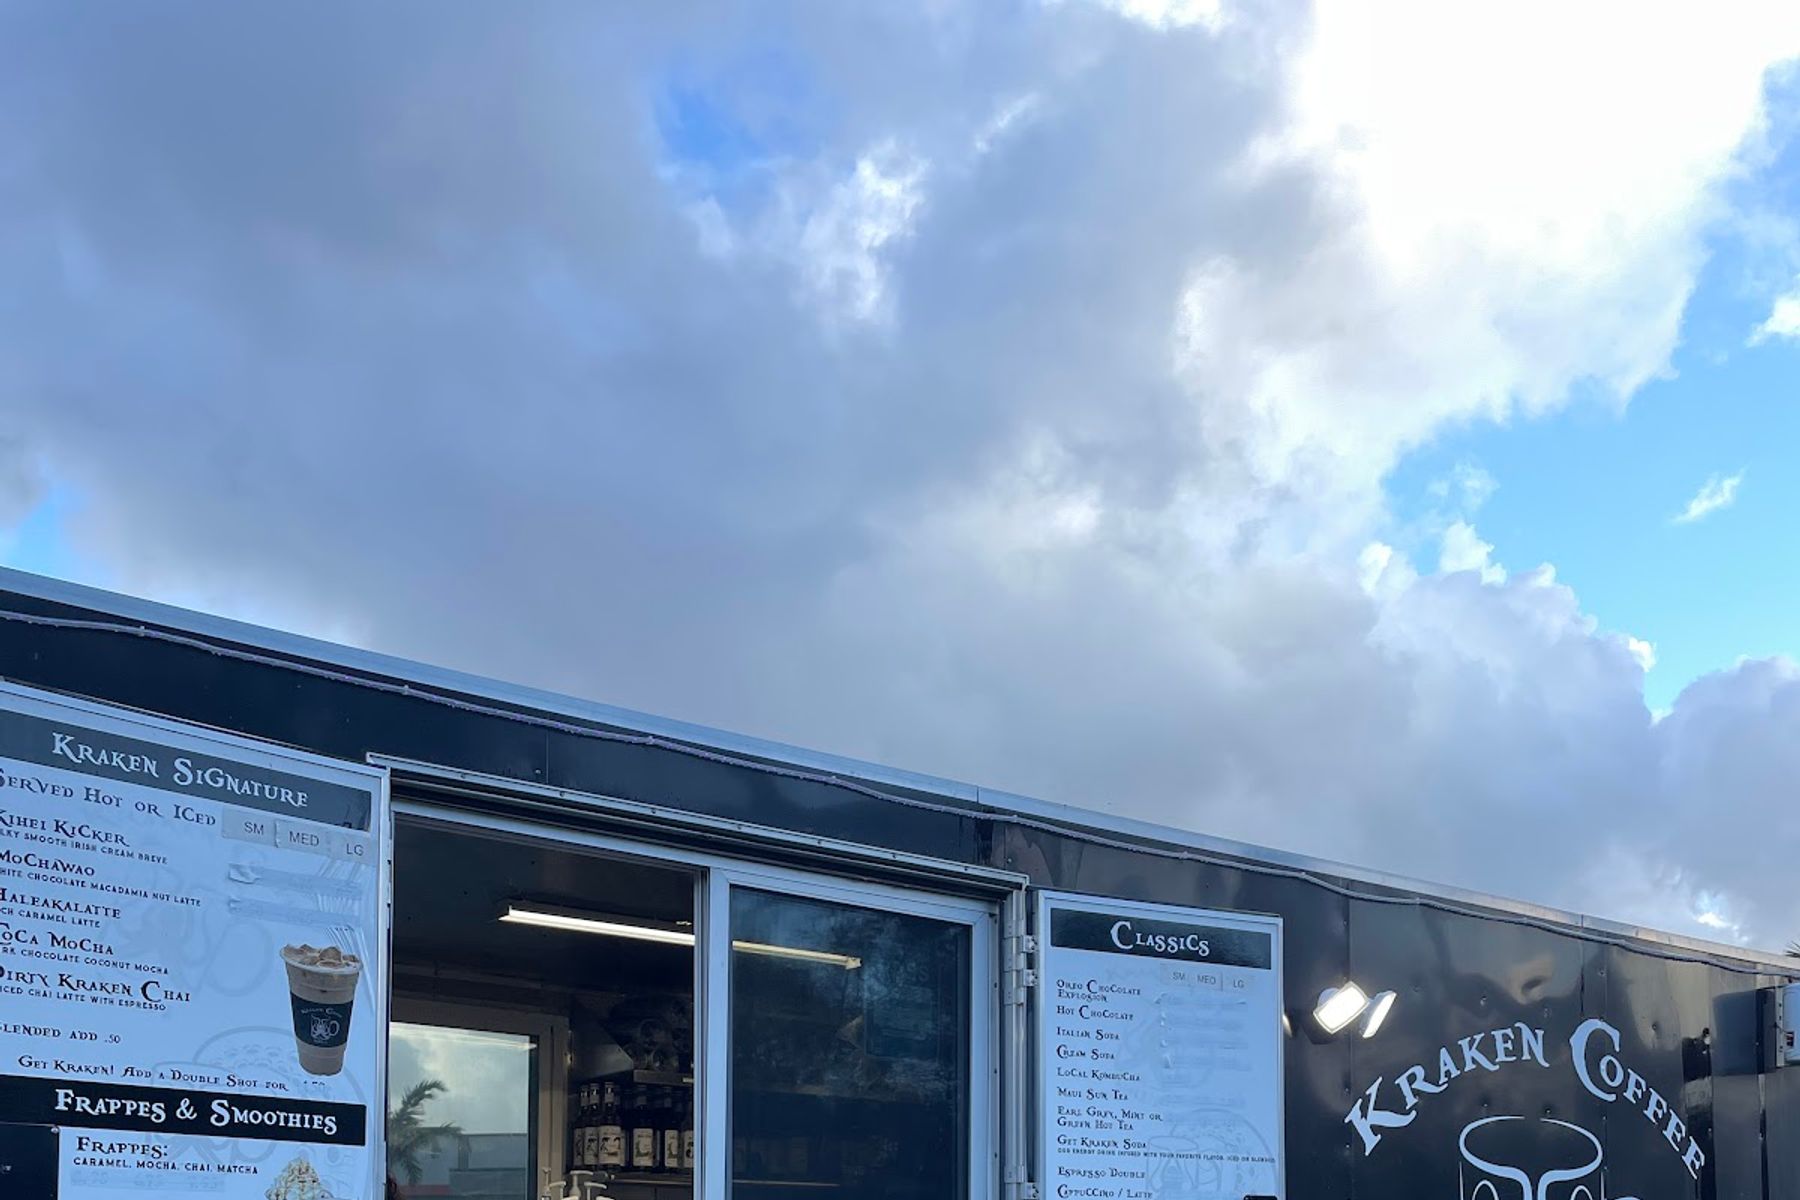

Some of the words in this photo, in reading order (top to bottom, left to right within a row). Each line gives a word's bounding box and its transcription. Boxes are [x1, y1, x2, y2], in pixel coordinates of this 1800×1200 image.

[52, 732, 159, 777] KRAKEN
[173, 757, 309, 807] SIGNATURE
[84, 787, 123, 807] HOT
[135, 802, 163, 817] OR
[173, 804, 216, 826] ICED
[0, 809, 47, 831] KIHEI
[53, 819, 130, 847] KICKER
[243, 821, 265, 836] SM
[289, 831, 320, 847] MED
[346, 843, 364, 857] LG
[24, 832, 67, 847] SMOOTH
[71, 841, 97, 852] IRISH
[101, 846, 135, 859] CREAM
[27, 871, 87, 888] CHOCOLATE
[90, 882, 148, 899] MACADAMIA
[152, 892, 171, 903] NUT
[174, 895, 201, 907] LATTE
[18, 909, 67, 924] CARAMEL
[71, 917, 101, 928] LATTE
[48, 931, 114, 955] MOCHA
[1110, 920, 1210, 957] CLASSICS
[21, 949, 80, 963] CHOCOLATE
[84, 957, 130, 970] COCONUT
[134, 963, 168, 975] MOCHA
[58, 973, 133, 997] KRAKEN
[140, 981, 191, 1003] CHAI
[1056, 979, 1082, 990] OREO
[1086, 979, 1141, 995] CHOCOLATE
[1172, 971, 1186, 981] SM
[1197, 975, 1216, 985] MED
[1233, 979, 1245, 988] LG
[28, 988, 52, 998] CHAI
[56, 991, 85, 1002] LATTE
[89, 995, 114, 1006] WITH
[118, 998, 166, 1011] ESPRESSO
[1058, 989, 1108, 1002] EXPLOSION
[1056, 1005, 1074, 1015] HOT
[1079, 1005, 1133, 1020] CHOCOLATE
[0, 1021, 61, 1038] LENDED
[69, 1030, 97, 1041] ADD
[104, 1034, 121, 1044] .50
[1056, 1026, 1090, 1039] ITALIAN
[1095, 1029, 1120, 1040] SODA
[1056, 1044, 1086, 1059] CREAM
[1091, 1048, 1115, 1060] SODA
[18, 1054, 48, 1070] GET
[54, 1059, 114, 1076] KRAKEN!
[121, 1066, 152, 1079] ADD
[158, 1072, 165, 1080] A
[170, 1069, 220, 1084] DOUBLE
[226, 1074, 258, 1088] SHOT
[265, 1081, 289, 1091] FOR
[1057, 1067, 1088, 1078] LOCAL
[1092, 1069, 1140, 1081] KOMBUCHA
[1057, 1086, 1081, 1097] MAUI
[1086, 1088, 1108, 1101] SUN
[1112, 1089, 1128, 1100] TEA
[1344, 1021, 1550, 1156] KRAKEN
[1568, 1018, 1705, 1179] COFFEE
[55, 1088, 166, 1124] FRAPPES
[175, 1098, 198, 1120] &
[210, 1099, 338, 1135] SMOOTHIES
[1057, 1105, 1082, 1116] EARL
[1121, 1109, 1144, 1119] MINT
[1149, 1113, 1163, 1121] OR
[1057, 1116, 1091, 1128] GREEN
[1095, 1119, 1113, 1129] HOT
[1117, 1119, 1134, 1130] TEA
[76, 1136, 168, 1159] FRAPPES:
[1057, 1134, 1077, 1146] GET
[1081, 1137, 1118, 1148] KRAKEN
[1123, 1138, 1146, 1149] SODA
[217, 1164, 258, 1174] MATCHA
[1057, 1166, 1107, 1178] ESPRESSO
[1109, 1167, 1145, 1178] DOUBLE
[1118, 1188, 1123, 1198] /
[1126, 1189, 1153, 1199] LATTE
